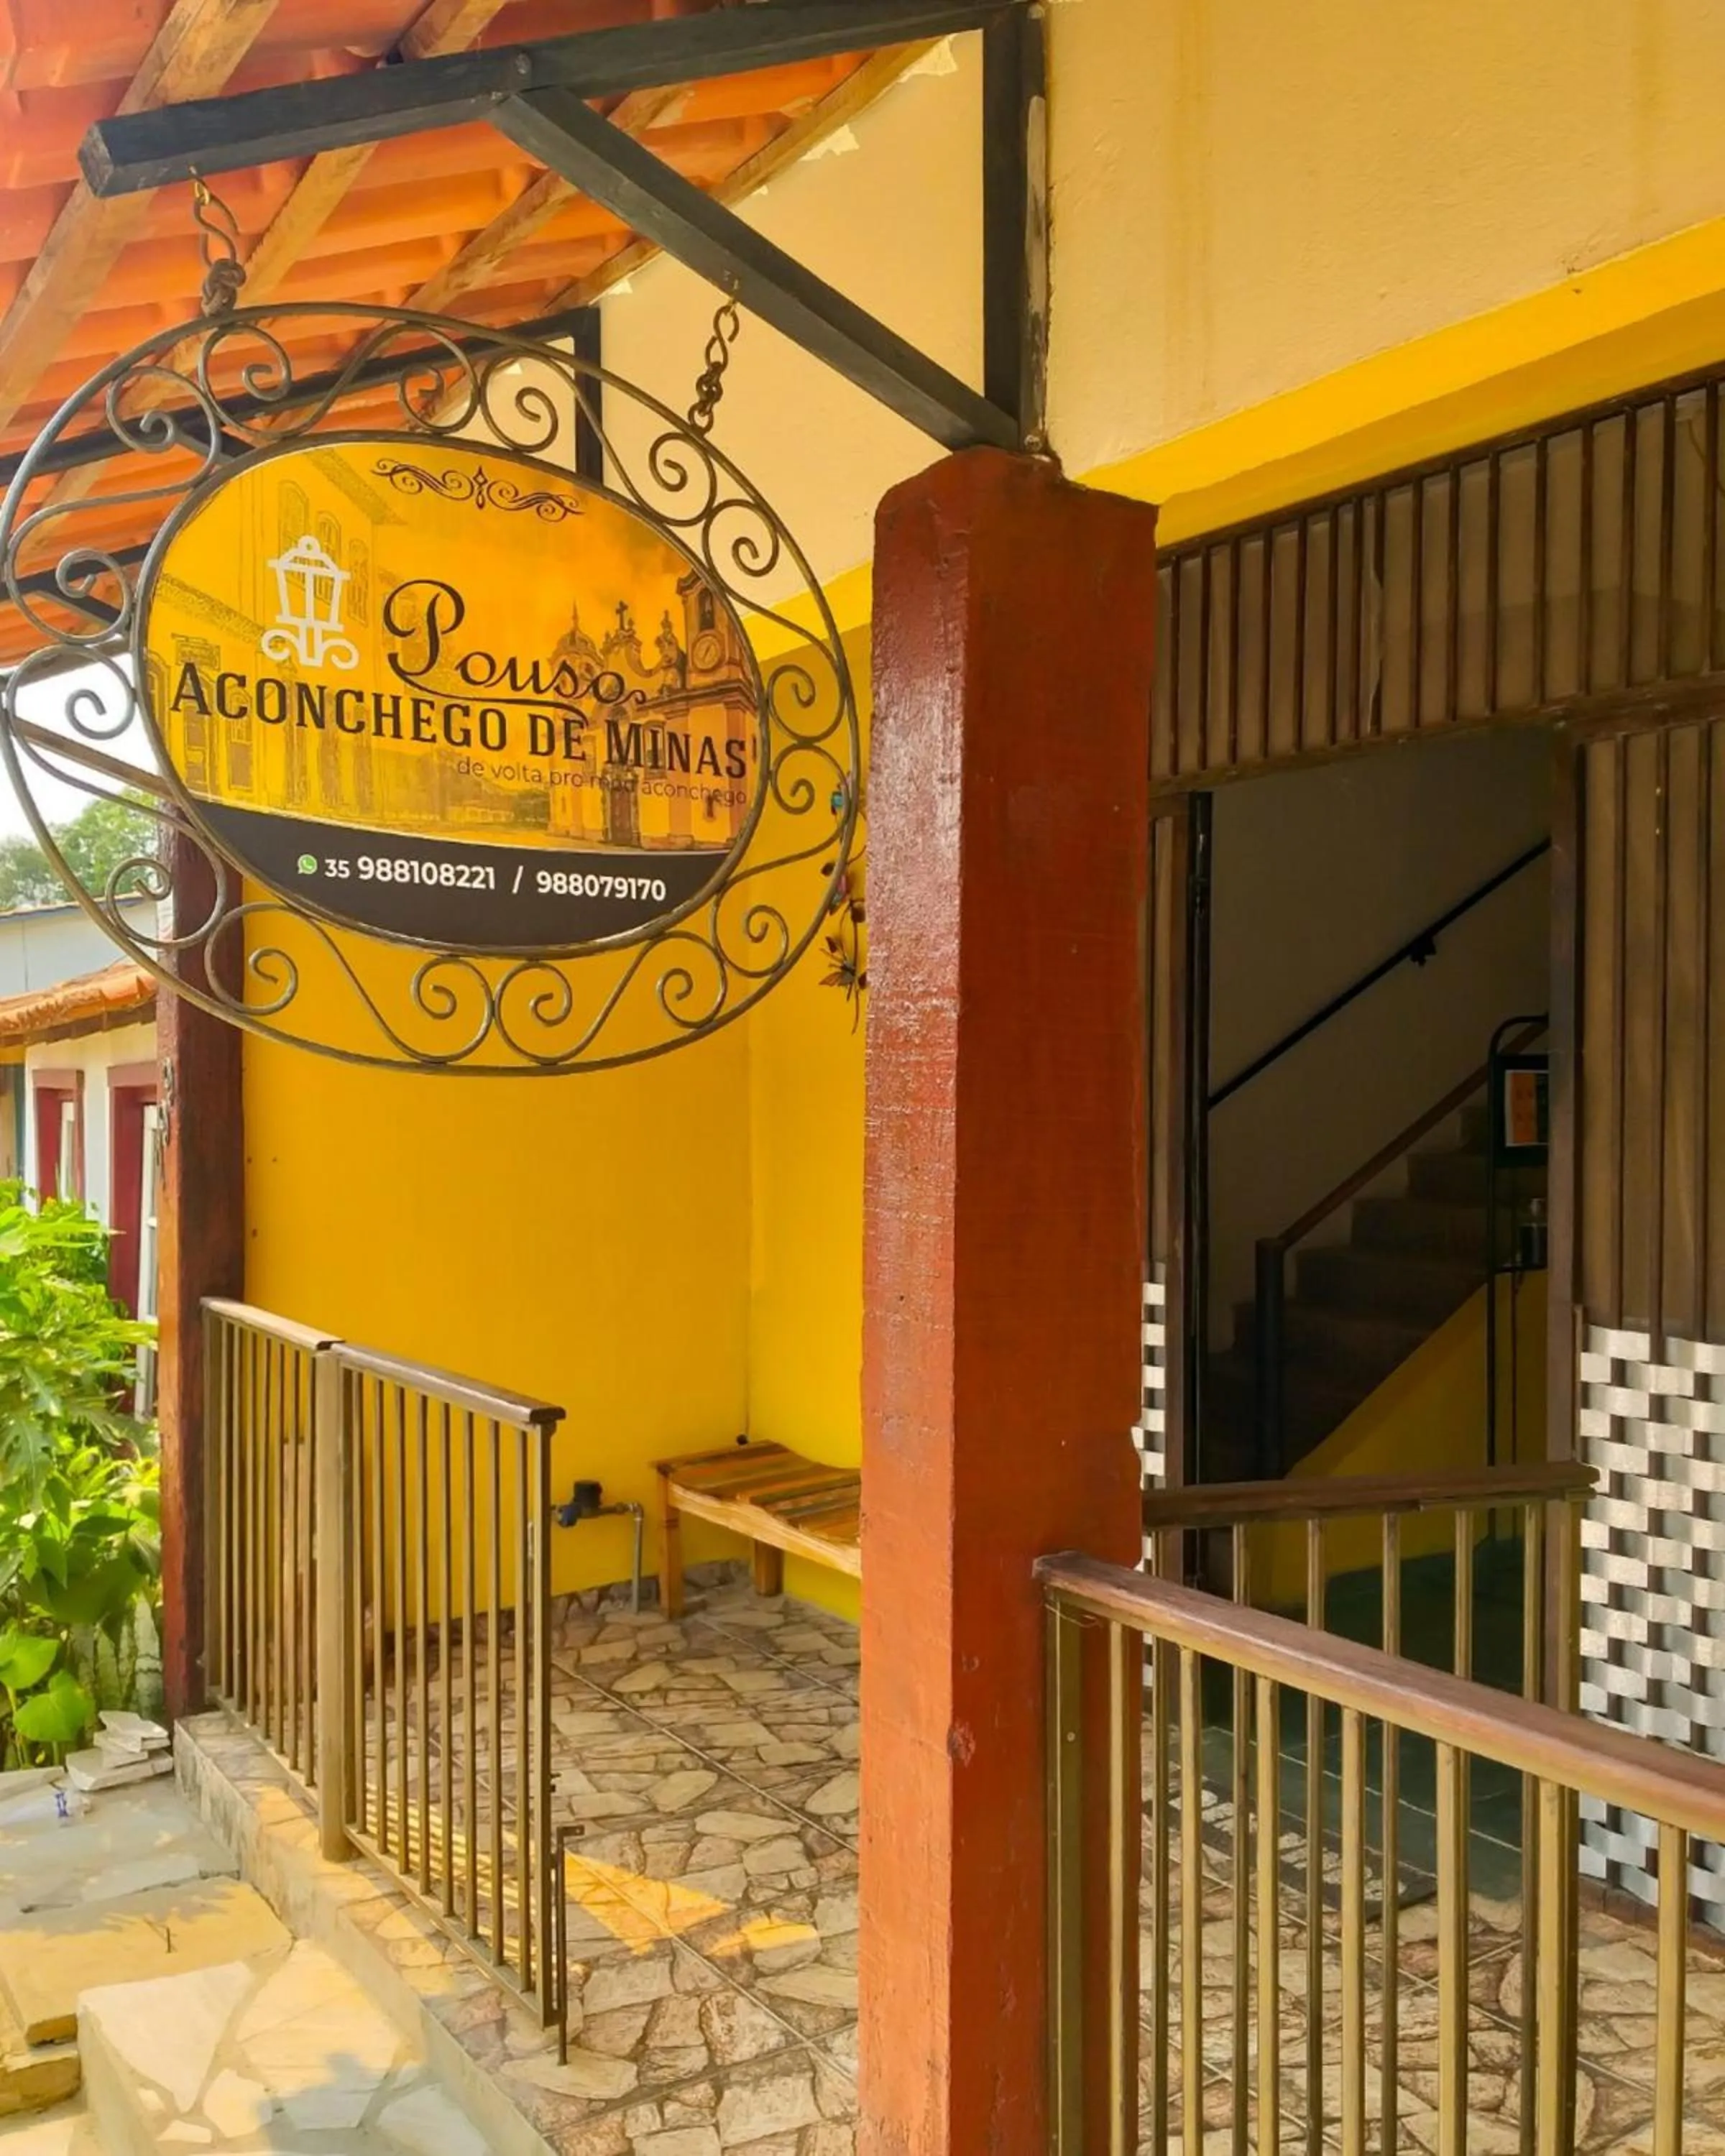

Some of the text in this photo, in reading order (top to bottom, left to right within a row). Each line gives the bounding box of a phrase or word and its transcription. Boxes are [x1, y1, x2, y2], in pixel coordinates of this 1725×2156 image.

[384, 579, 645, 720] Pouso
[170, 662, 746, 779] ACONCHEGO DE MINAS
[457, 757, 485, 777] de
[492, 765, 542, 783] volta
[550, 769, 583, 790] pro
[642, 780, 747, 807] aconchego
[325, 859, 351, 879] 35
[357, 856, 496, 890] 988108221
[536, 870, 667, 902] 988079170
